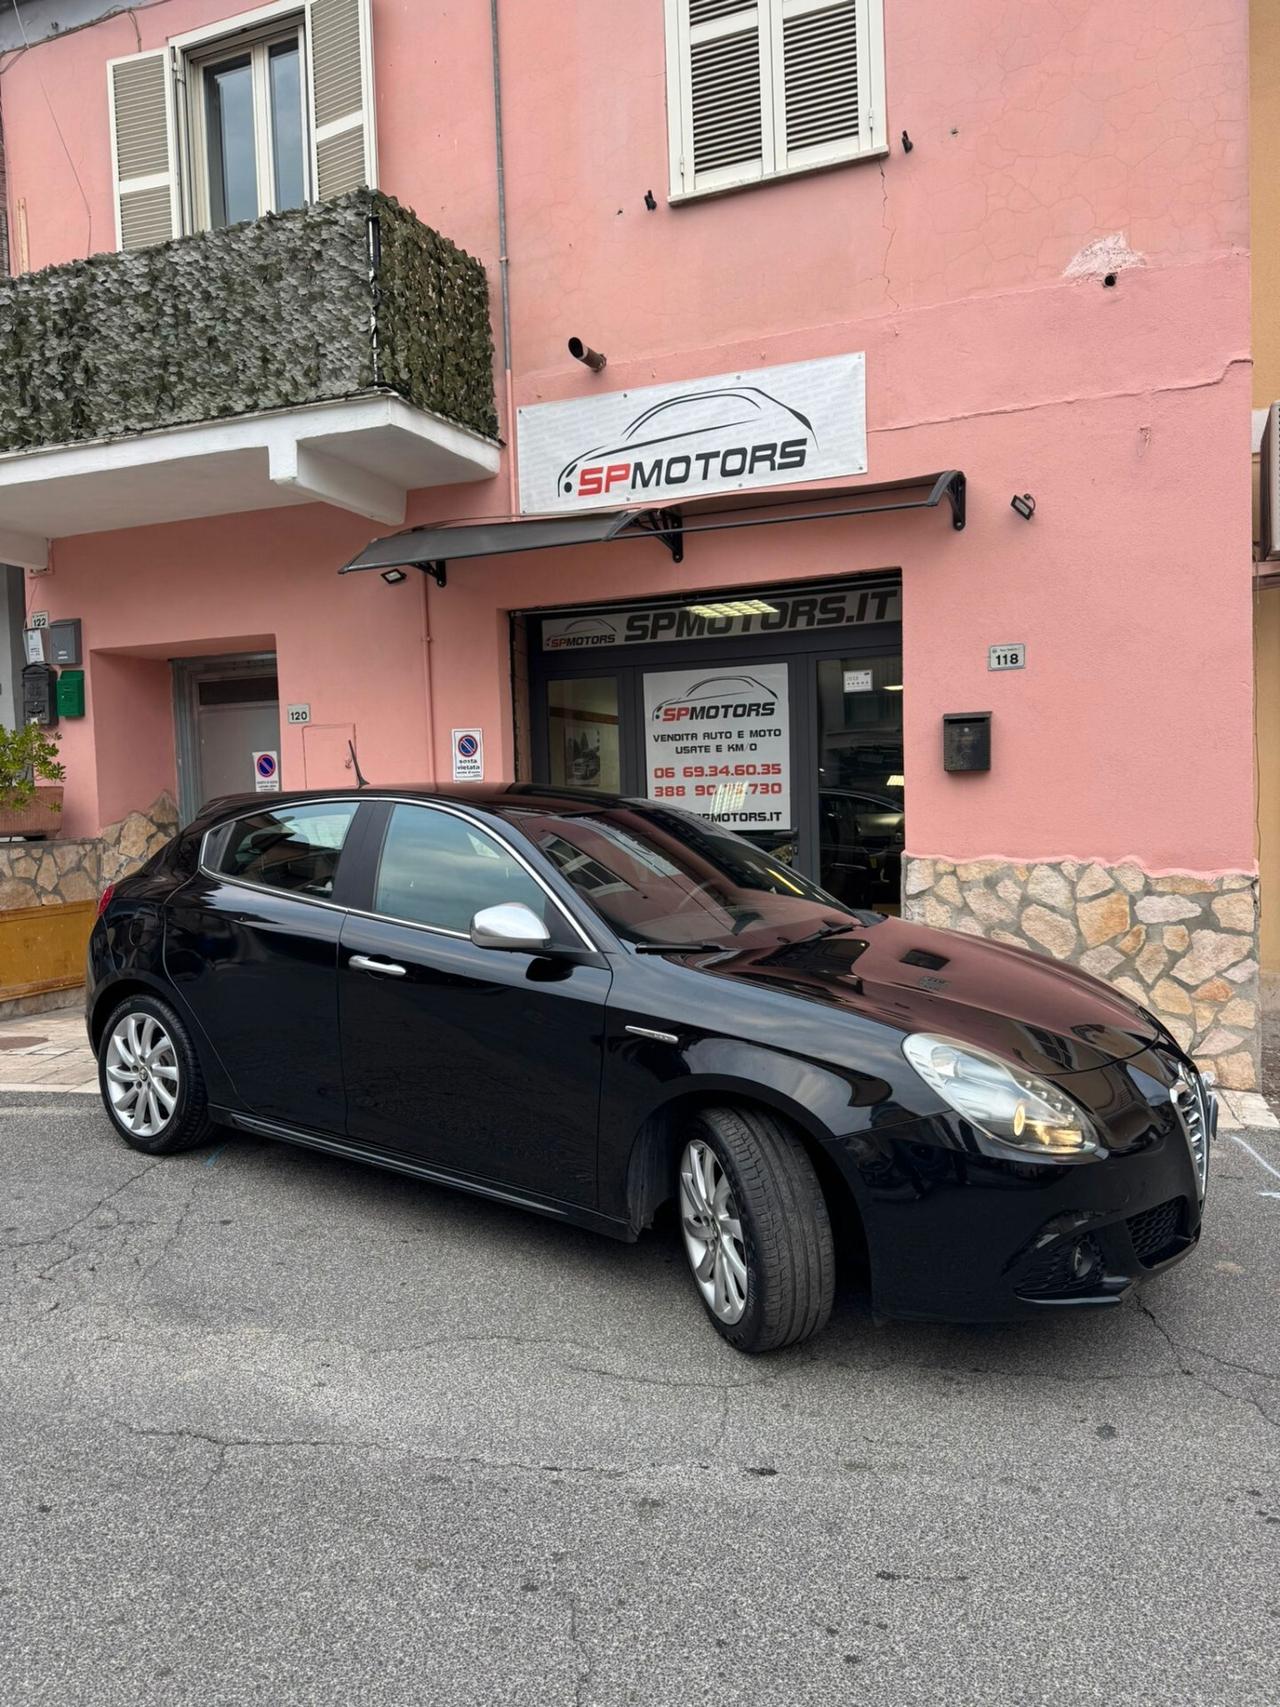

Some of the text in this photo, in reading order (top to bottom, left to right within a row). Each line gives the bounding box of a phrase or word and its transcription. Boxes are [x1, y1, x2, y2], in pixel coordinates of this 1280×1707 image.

[577, 437, 808, 497] SPMOTORS
[33, 617, 46, 627] 122
[551, 634, 616, 648] SPMOTORS
[995, 653, 1019, 666] 118
[290, 711, 308, 721] 120
[662, 702, 776, 722] SPMOTORS
[653, 728, 782, 742] VENDITA AUTO E MOTO
[675, 745, 711, 755] USATE
[715, 744, 723, 753] E
[654, 763, 782, 779] 06 69.34.60.35
[654, 786, 686, 798] 388
